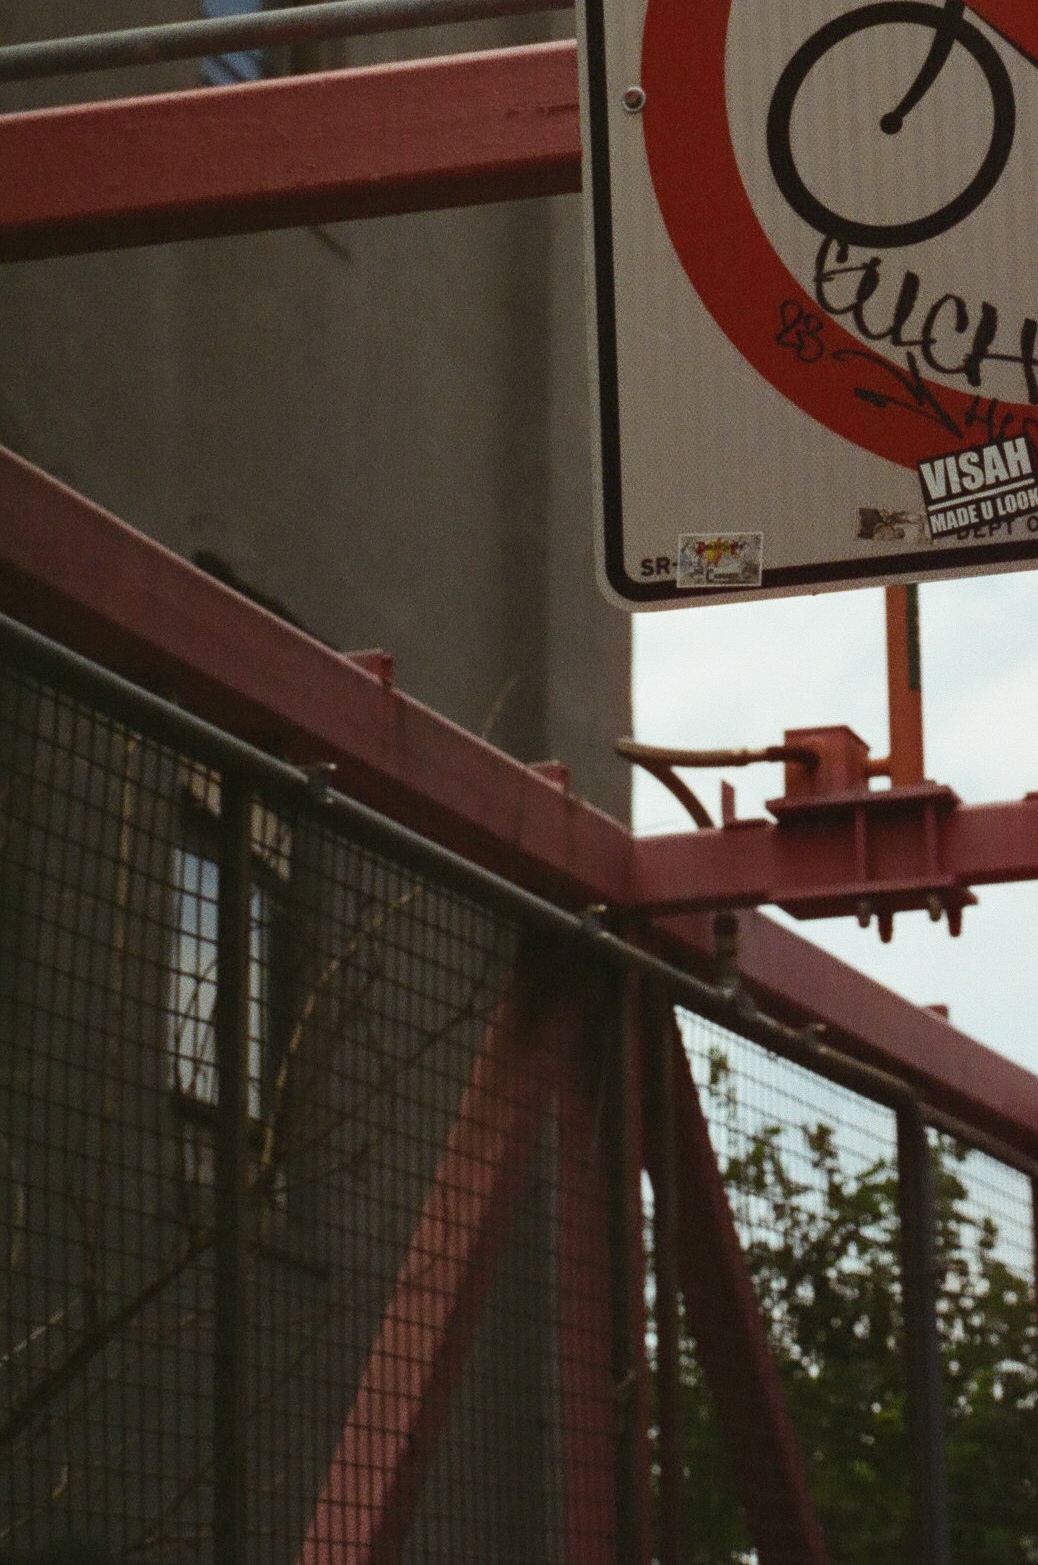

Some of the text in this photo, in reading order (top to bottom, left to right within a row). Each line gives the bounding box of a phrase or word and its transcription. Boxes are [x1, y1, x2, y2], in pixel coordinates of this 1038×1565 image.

[919, 437, 1033, 500] VISAH
[929, 504, 980, 534] MADE
[980, 499, 995, 521] U
